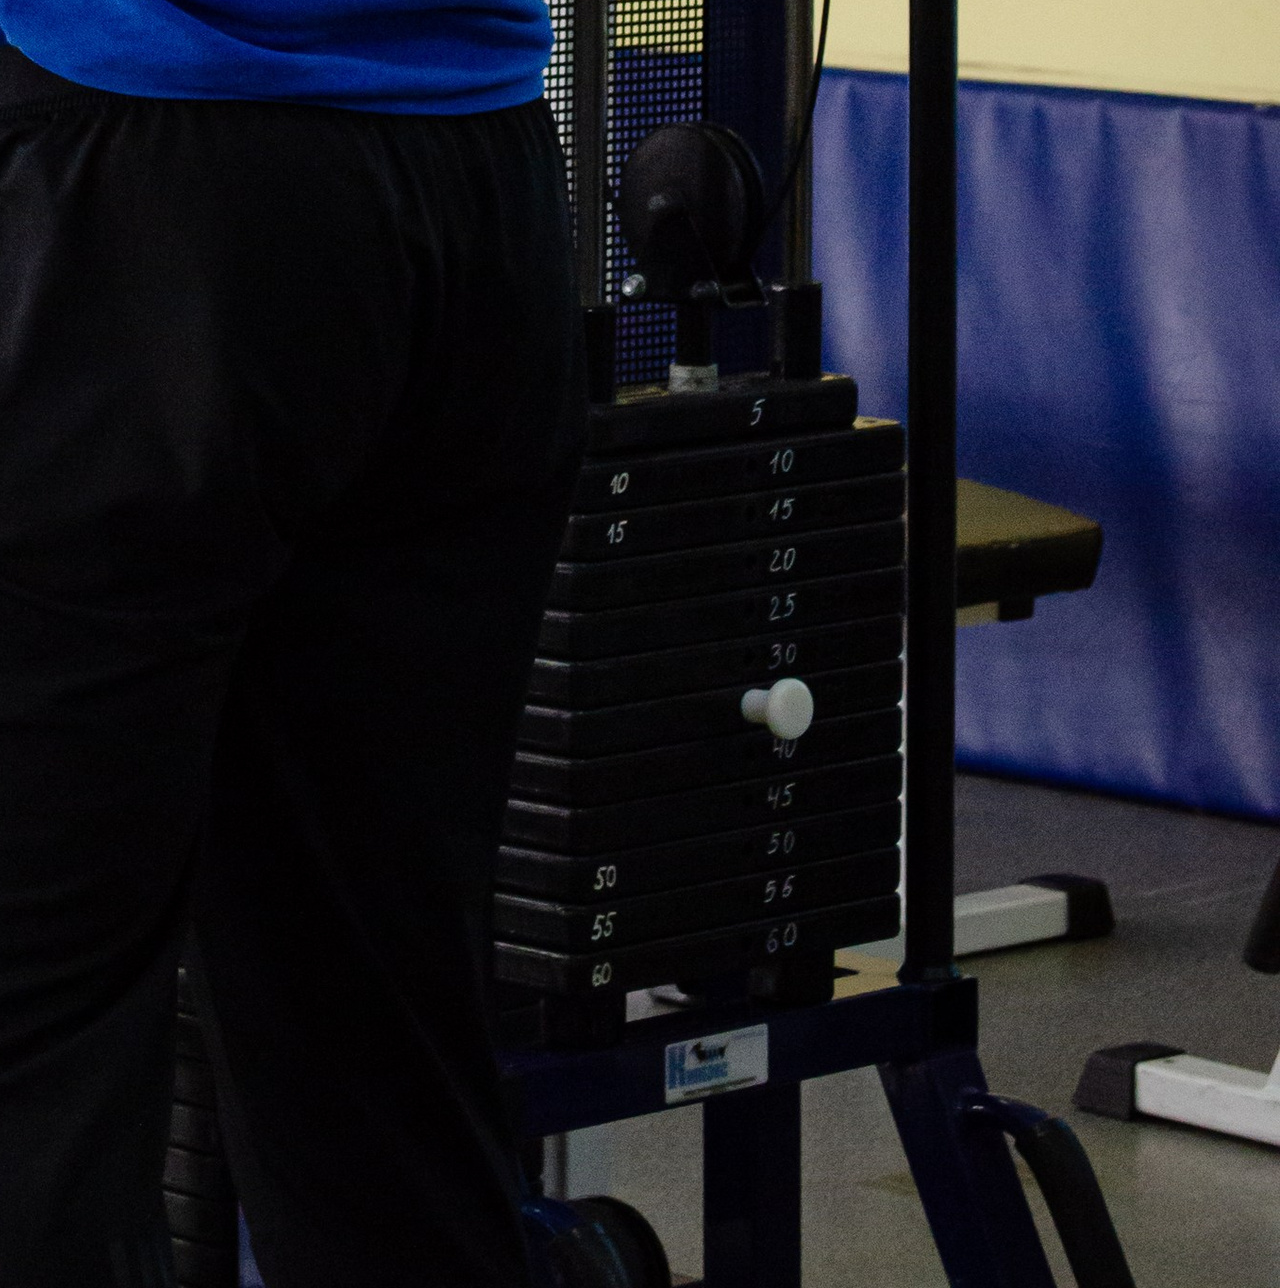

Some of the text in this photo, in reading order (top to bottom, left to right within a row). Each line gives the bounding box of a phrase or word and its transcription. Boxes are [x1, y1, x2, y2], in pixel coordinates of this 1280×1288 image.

[749, 397, 767, 427] 5
[770, 448, 795, 474] 10
[609, 471, 630, 495] 10
[769, 497, 796, 521] 15
[606, 519, 628, 545] 15
[770, 547, 797, 573] 20
[770, 591, 797, 621] 25
[768, 642, 797, 670] 30
[767, 781, 797, 811] 45
[767, 830, 796, 855] 50
[593, 864, 617, 890] 50
[591, 910, 618, 941] 55
[766, 922, 798, 953] 60
[591, 961, 613, 988] 60
